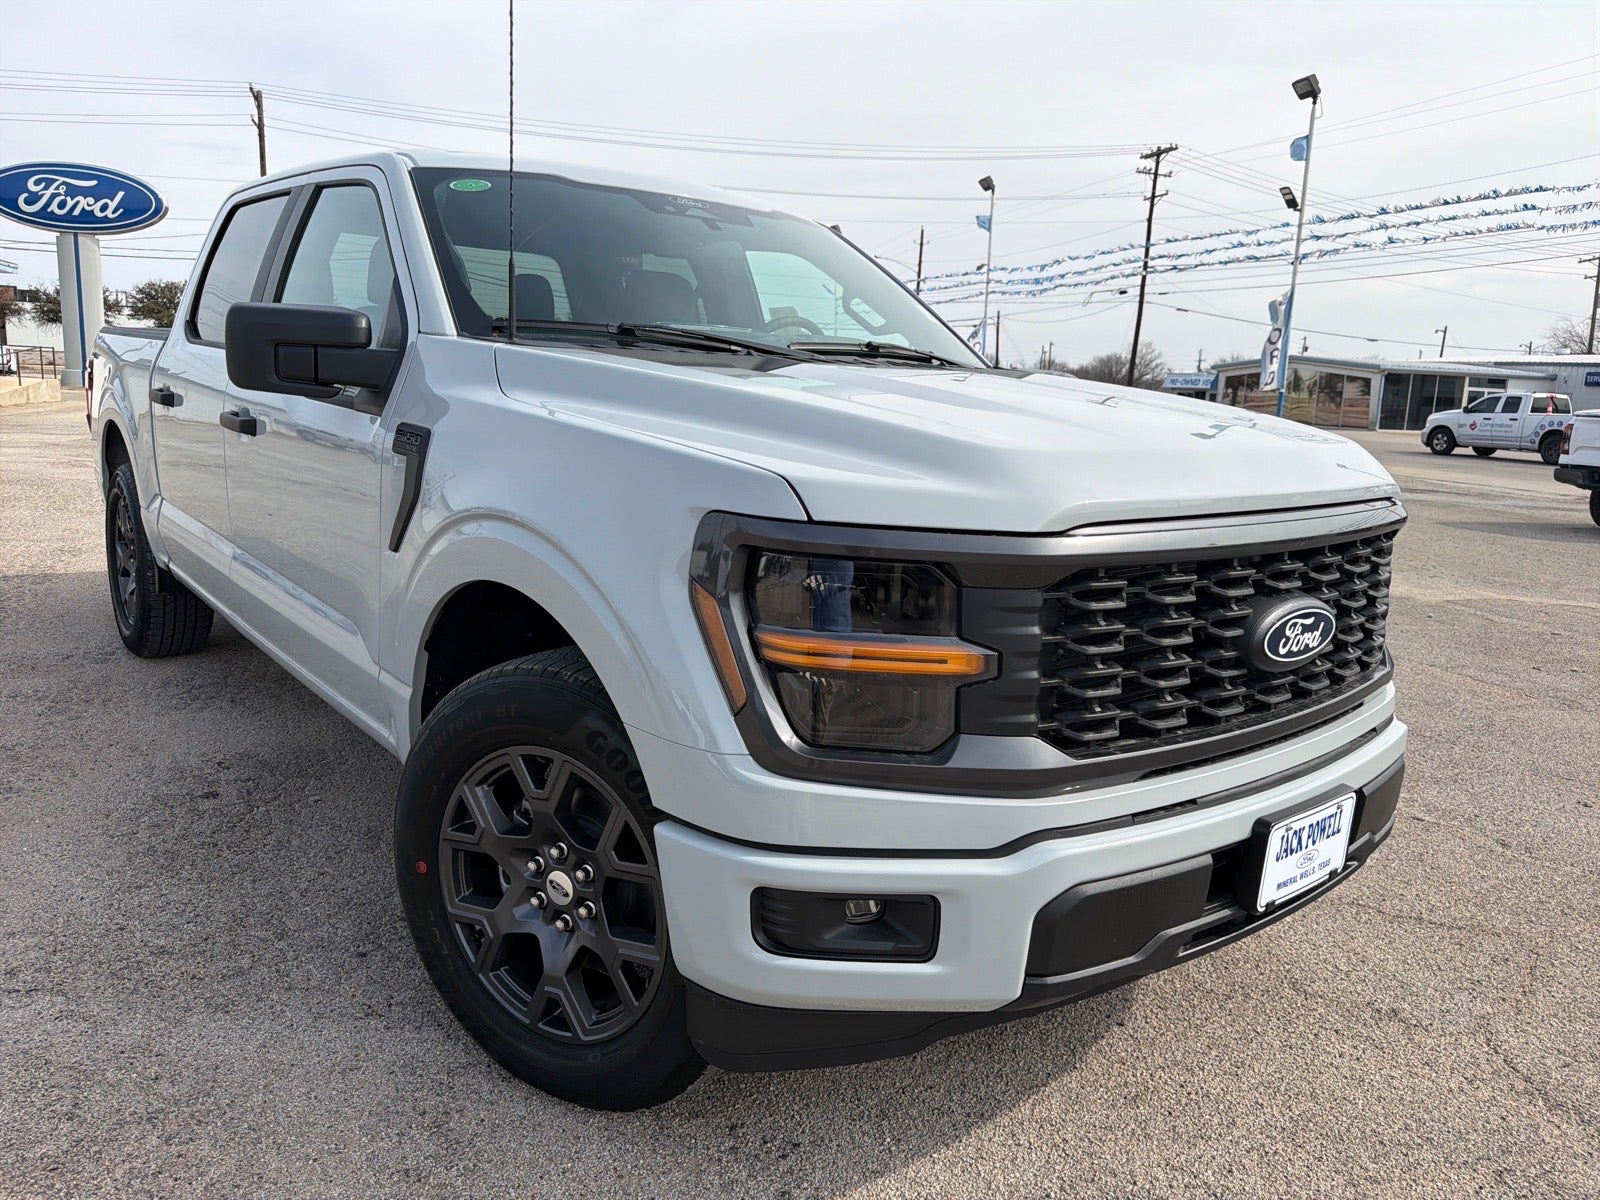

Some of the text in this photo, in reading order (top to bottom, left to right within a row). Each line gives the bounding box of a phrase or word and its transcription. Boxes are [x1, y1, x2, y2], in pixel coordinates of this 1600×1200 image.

[18, 174, 126, 219] Ford
[1264, 299, 1284, 387] ORD
[1278, 616, 1325, 655] Ford
[1276, 808, 1343, 863] JACK POWELL
[1276, 874, 1298, 891] MINERAL
[1317, 858, 1331, 871] TEXAS
